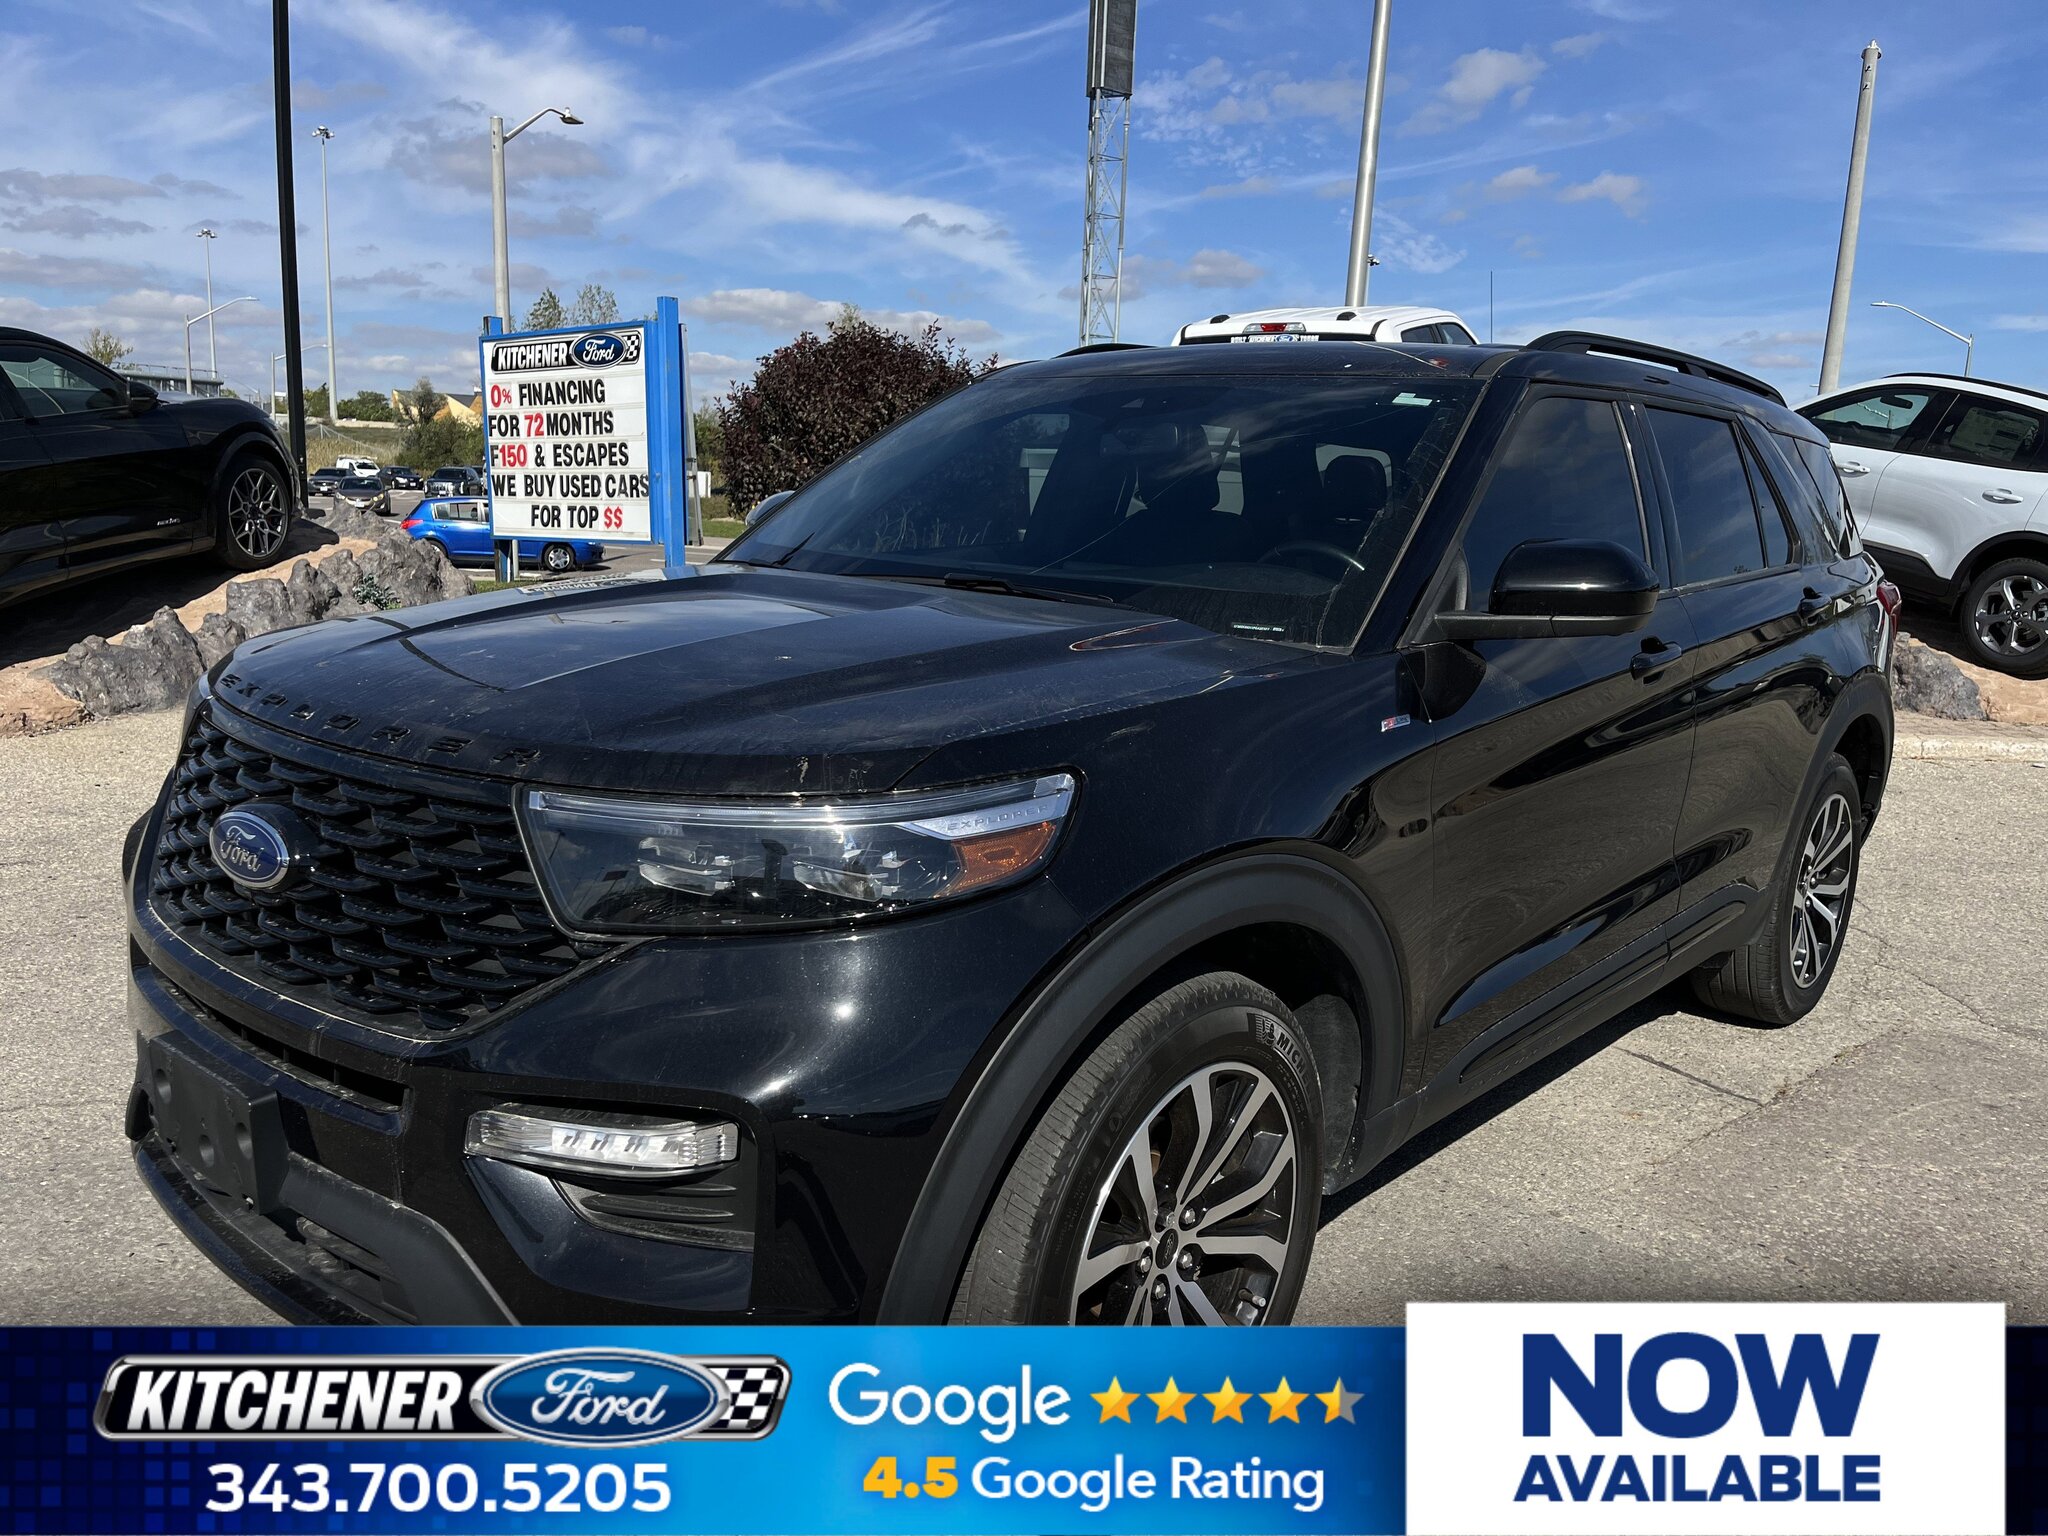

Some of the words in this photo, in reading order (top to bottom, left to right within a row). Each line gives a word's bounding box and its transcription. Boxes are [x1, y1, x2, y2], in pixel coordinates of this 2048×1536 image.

[498, 343, 568, 370] KITCHENER
[583, 339, 616, 362] Ford
[491, 384, 512, 407] 0%
[519, 379, 606, 406] FINANCING
[488, 415, 520, 437] FOR
[524, 413, 544, 437] 72
[546, 411, 614, 436] MONTHS
[490, 444, 527, 467] F150
[534, 444, 545, 467] &
[553, 443, 629, 467] ESCAPES
[491, 475, 517, 497] WE
[524, 474, 556, 497] BUY
[560, 475, 601, 498] USED
[605, 474, 650, 498] CARS
[531, 505, 561, 528] FOR
[568, 505, 599, 528] TOP
[603, 506, 623, 529] $$
[220, 672, 542, 768] EXPLORER
[946, 805, 1048, 831] EXPLORER
[220, 825, 265, 872] Ford
